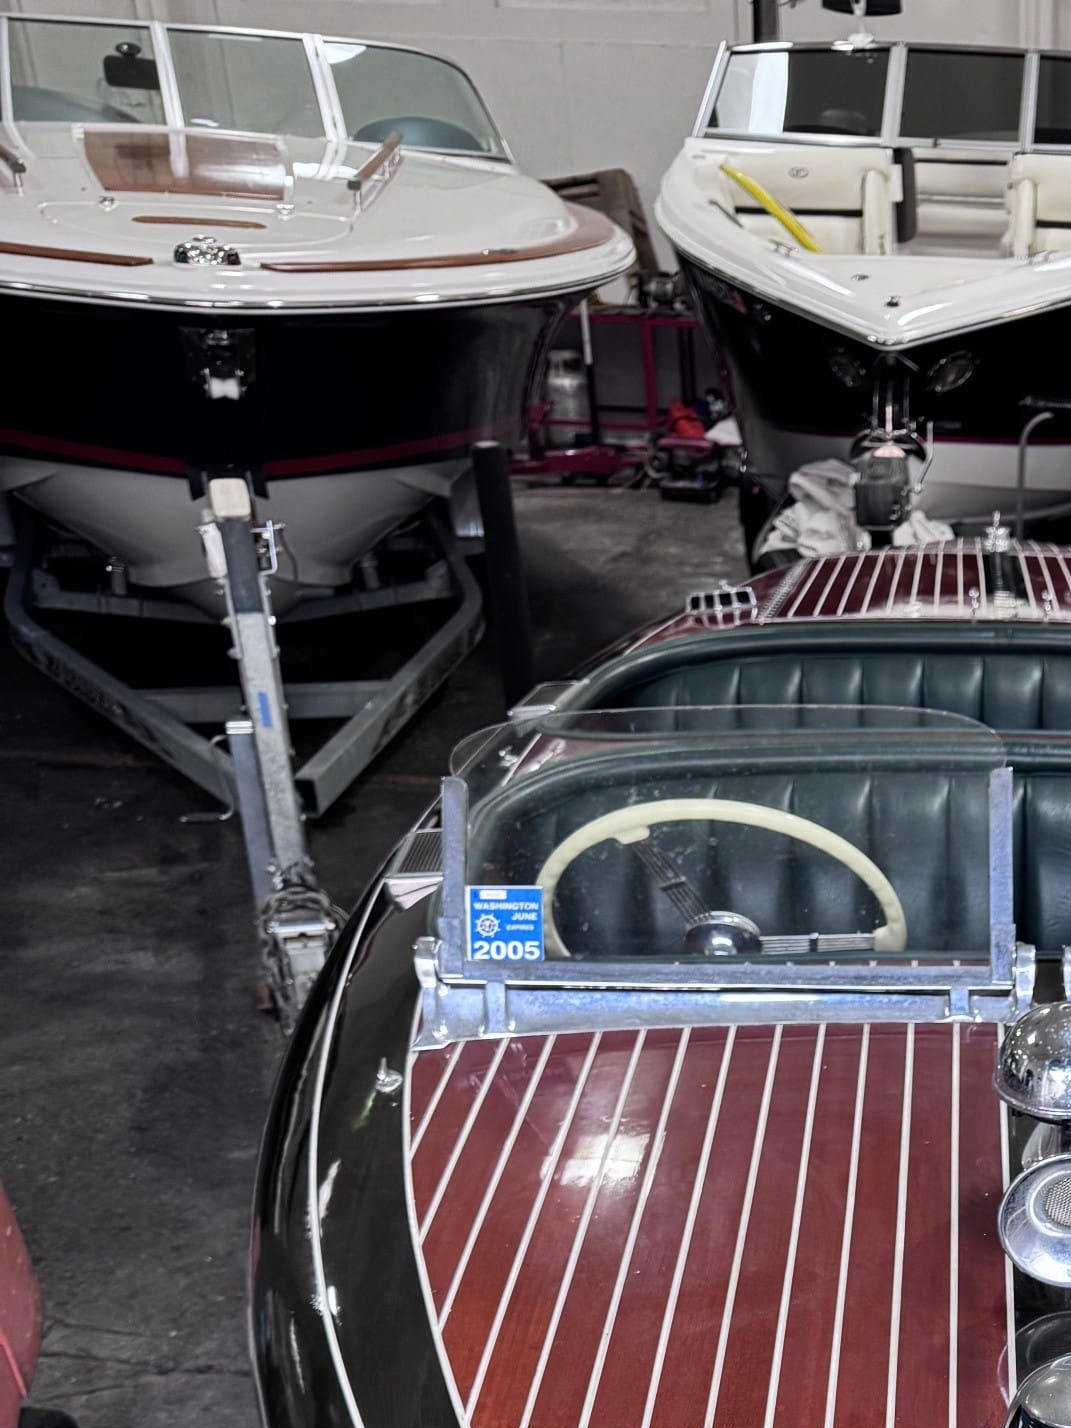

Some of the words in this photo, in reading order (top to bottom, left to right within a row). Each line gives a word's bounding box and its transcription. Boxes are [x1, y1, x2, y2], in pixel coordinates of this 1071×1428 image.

[473, 902, 539, 911] WASHINGTON
[511, 912, 537, 921] JUNE
[473, 940, 540, 961] 2005
